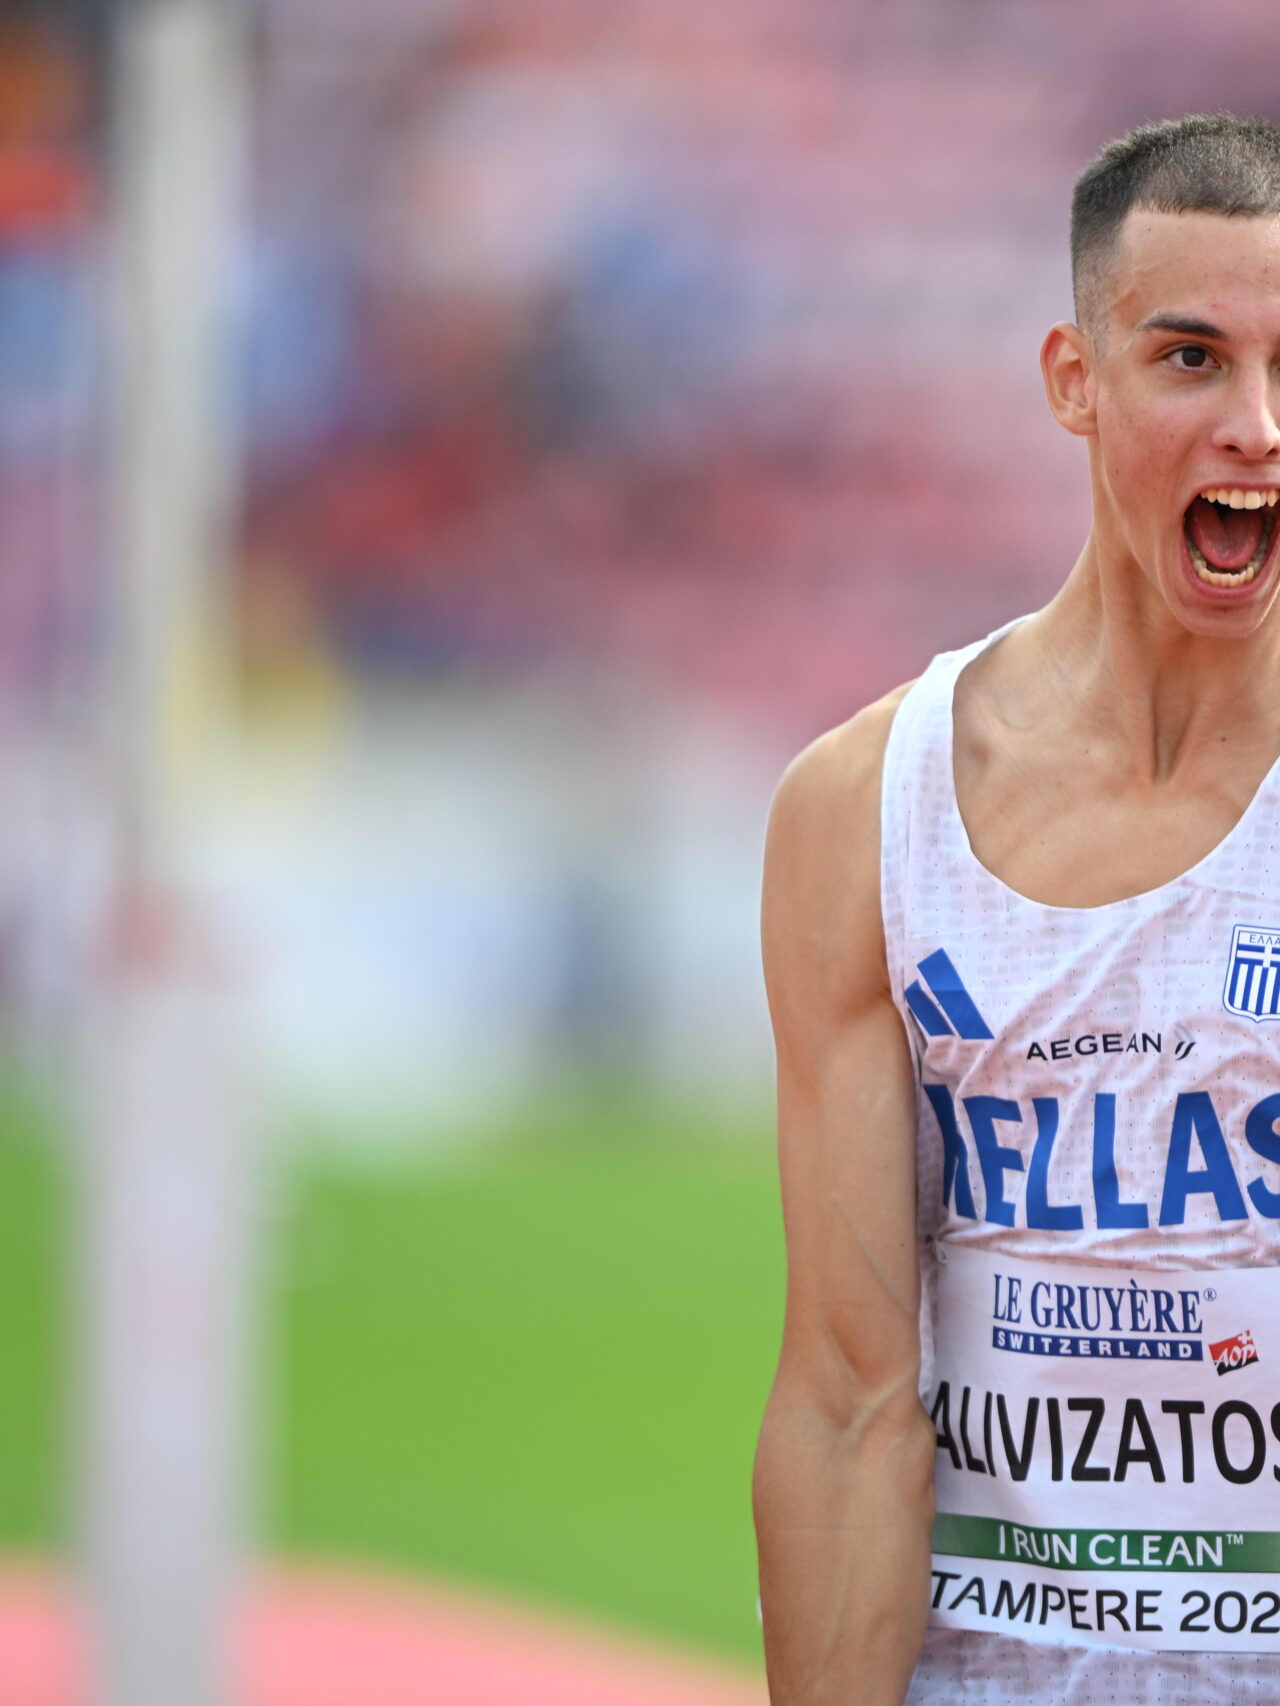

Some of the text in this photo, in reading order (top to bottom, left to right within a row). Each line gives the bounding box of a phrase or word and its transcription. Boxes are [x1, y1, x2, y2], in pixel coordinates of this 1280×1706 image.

[1026, 1032, 1162, 1062] AEGEAN
[993, 1273, 1022, 1324] LE
[997, 1331, 1193, 1358] SWITZERLAND
[1214, 1343, 1256, 1369] AOP
[999, 1524, 1006, 1556] I
[1013, 1526, 1078, 1565] RUN
[931, 1570, 1163, 1633] TAMPERE
